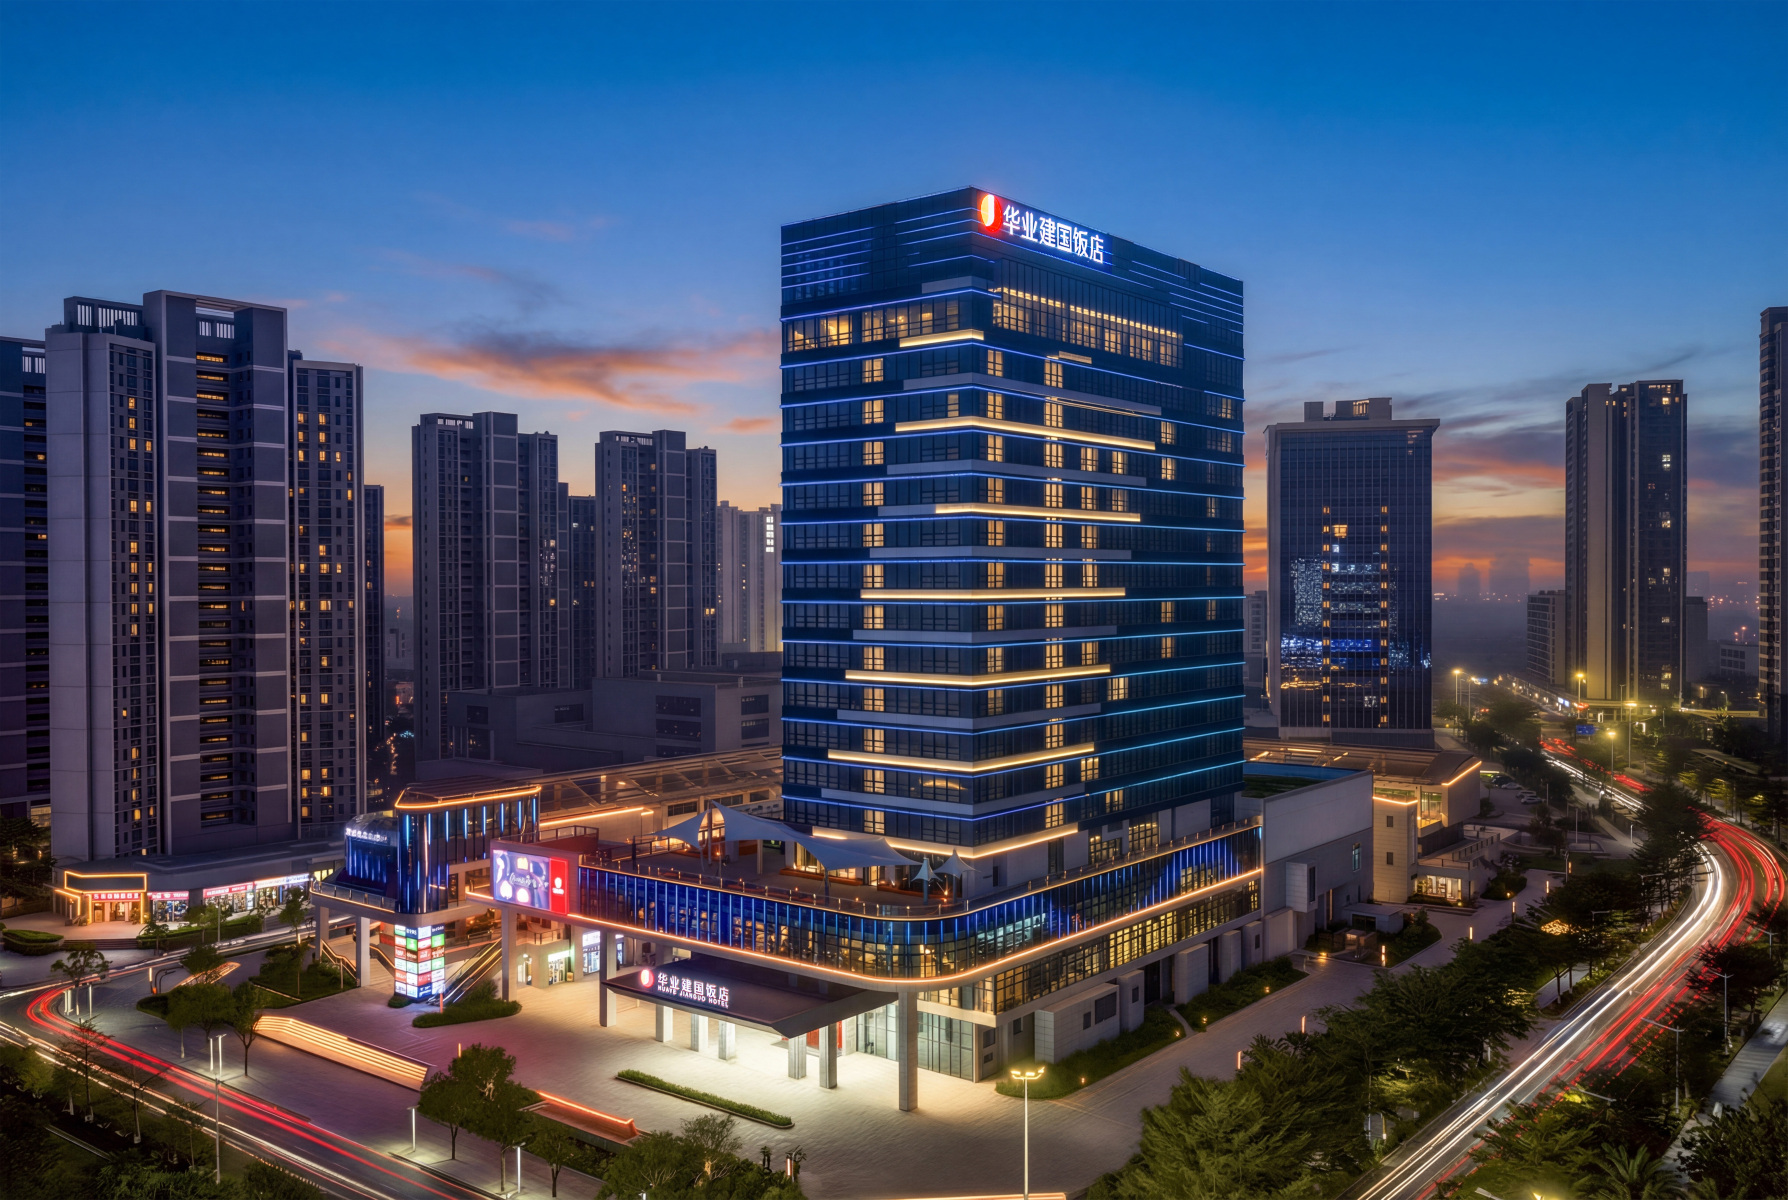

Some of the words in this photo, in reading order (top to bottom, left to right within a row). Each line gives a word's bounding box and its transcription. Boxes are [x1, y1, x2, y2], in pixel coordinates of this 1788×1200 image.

[1003, 205, 1104, 264] 华业建国饭店
[658, 973, 729, 1002] 华业建国饭店
[708, 998, 729, 1009] HOTEL
